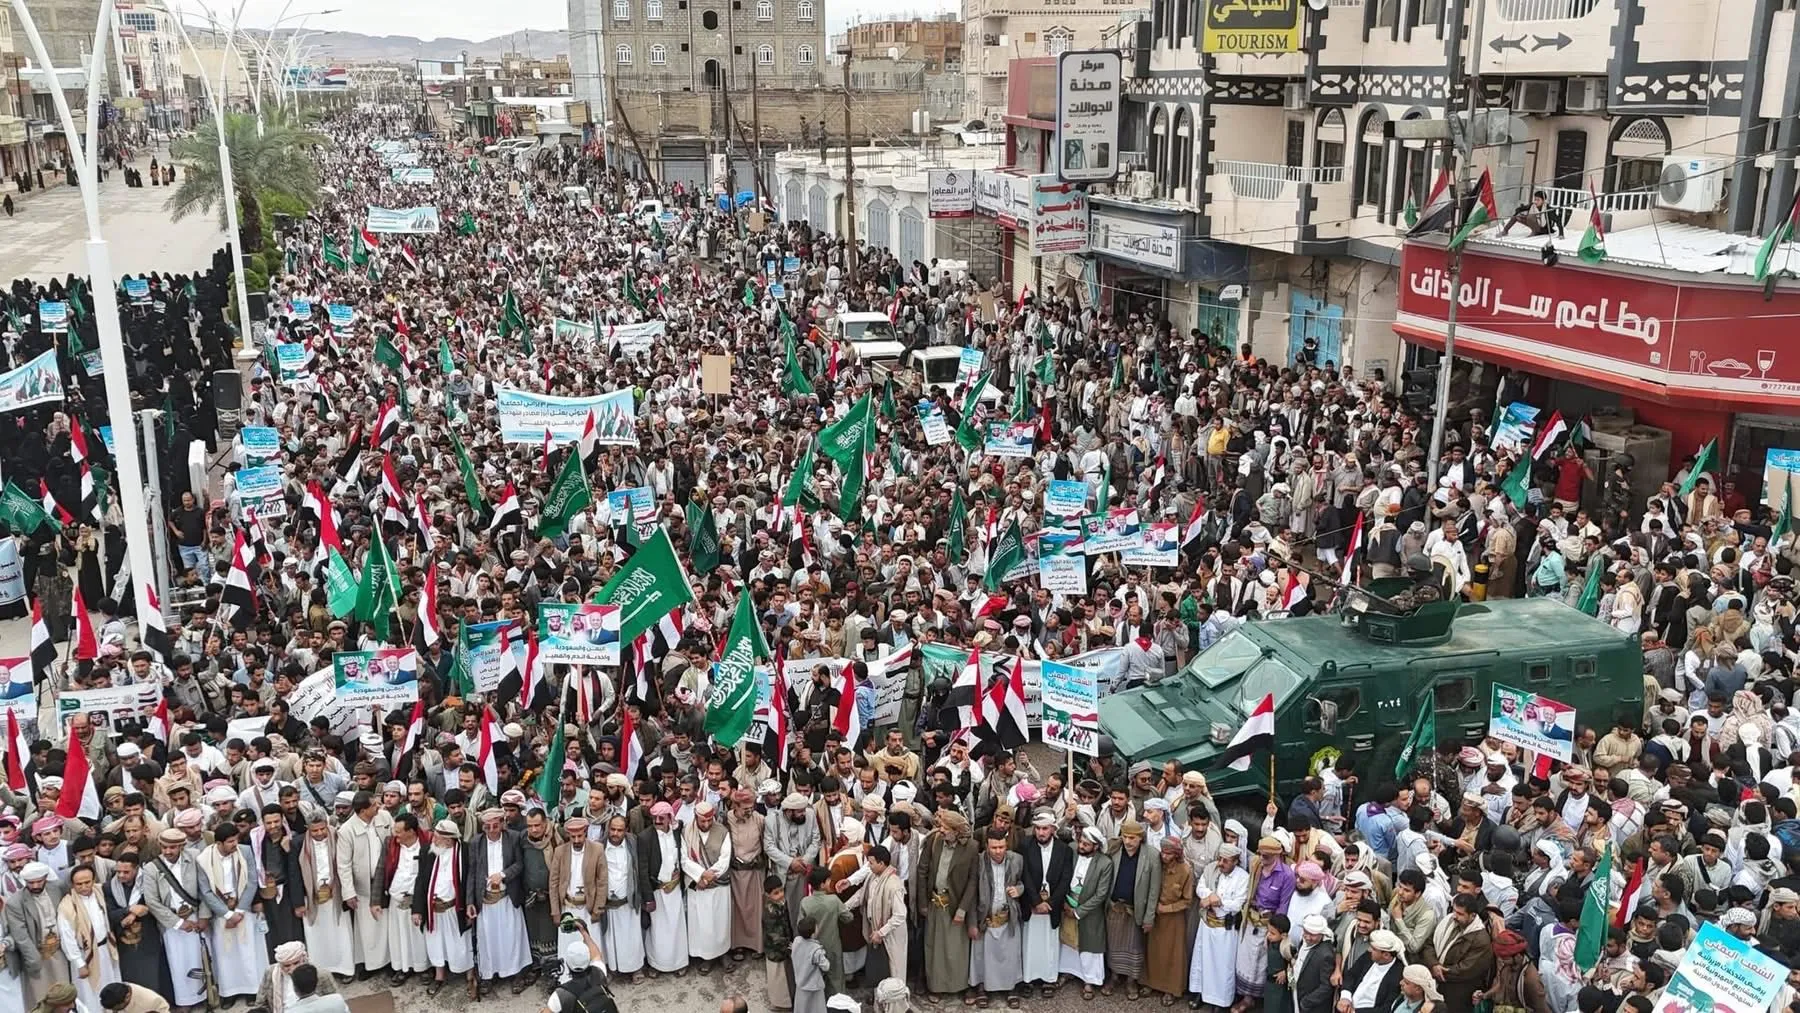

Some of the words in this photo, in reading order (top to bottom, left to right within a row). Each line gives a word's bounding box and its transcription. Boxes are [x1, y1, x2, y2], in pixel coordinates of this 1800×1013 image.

[1217, 34, 1289, 50] TOURISM
[1079, 59, 1105, 73] مركز
[1070, 78, 1112, 92] هدنة
[1068, 101, 1113, 116] للجوالات
[931, 187, 956, 197] المعاوز
[957, 186, 971, 196] أمير
[1035, 216, 1085, 237] والسلام
[1161, 229, 1173, 240] مركز
[1152, 240, 1173, 257] هدنة
[1410, 267, 1491, 309] المذاق
[1491, 289, 1552, 319] سر
[1555, 298, 1661, 345] مطاعم
[1704, 938, 1740, 960] اليمني
[1692, 959, 1707, 972] التي
[1740, 957, 1775, 981] الشعب
[1692, 968, 1714, 983] العربية
[1711, 980, 1730, 993] الدول
[1731, 981, 1763, 1004] والمشاريع
[1744, 979, 1767, 996] يرفض
